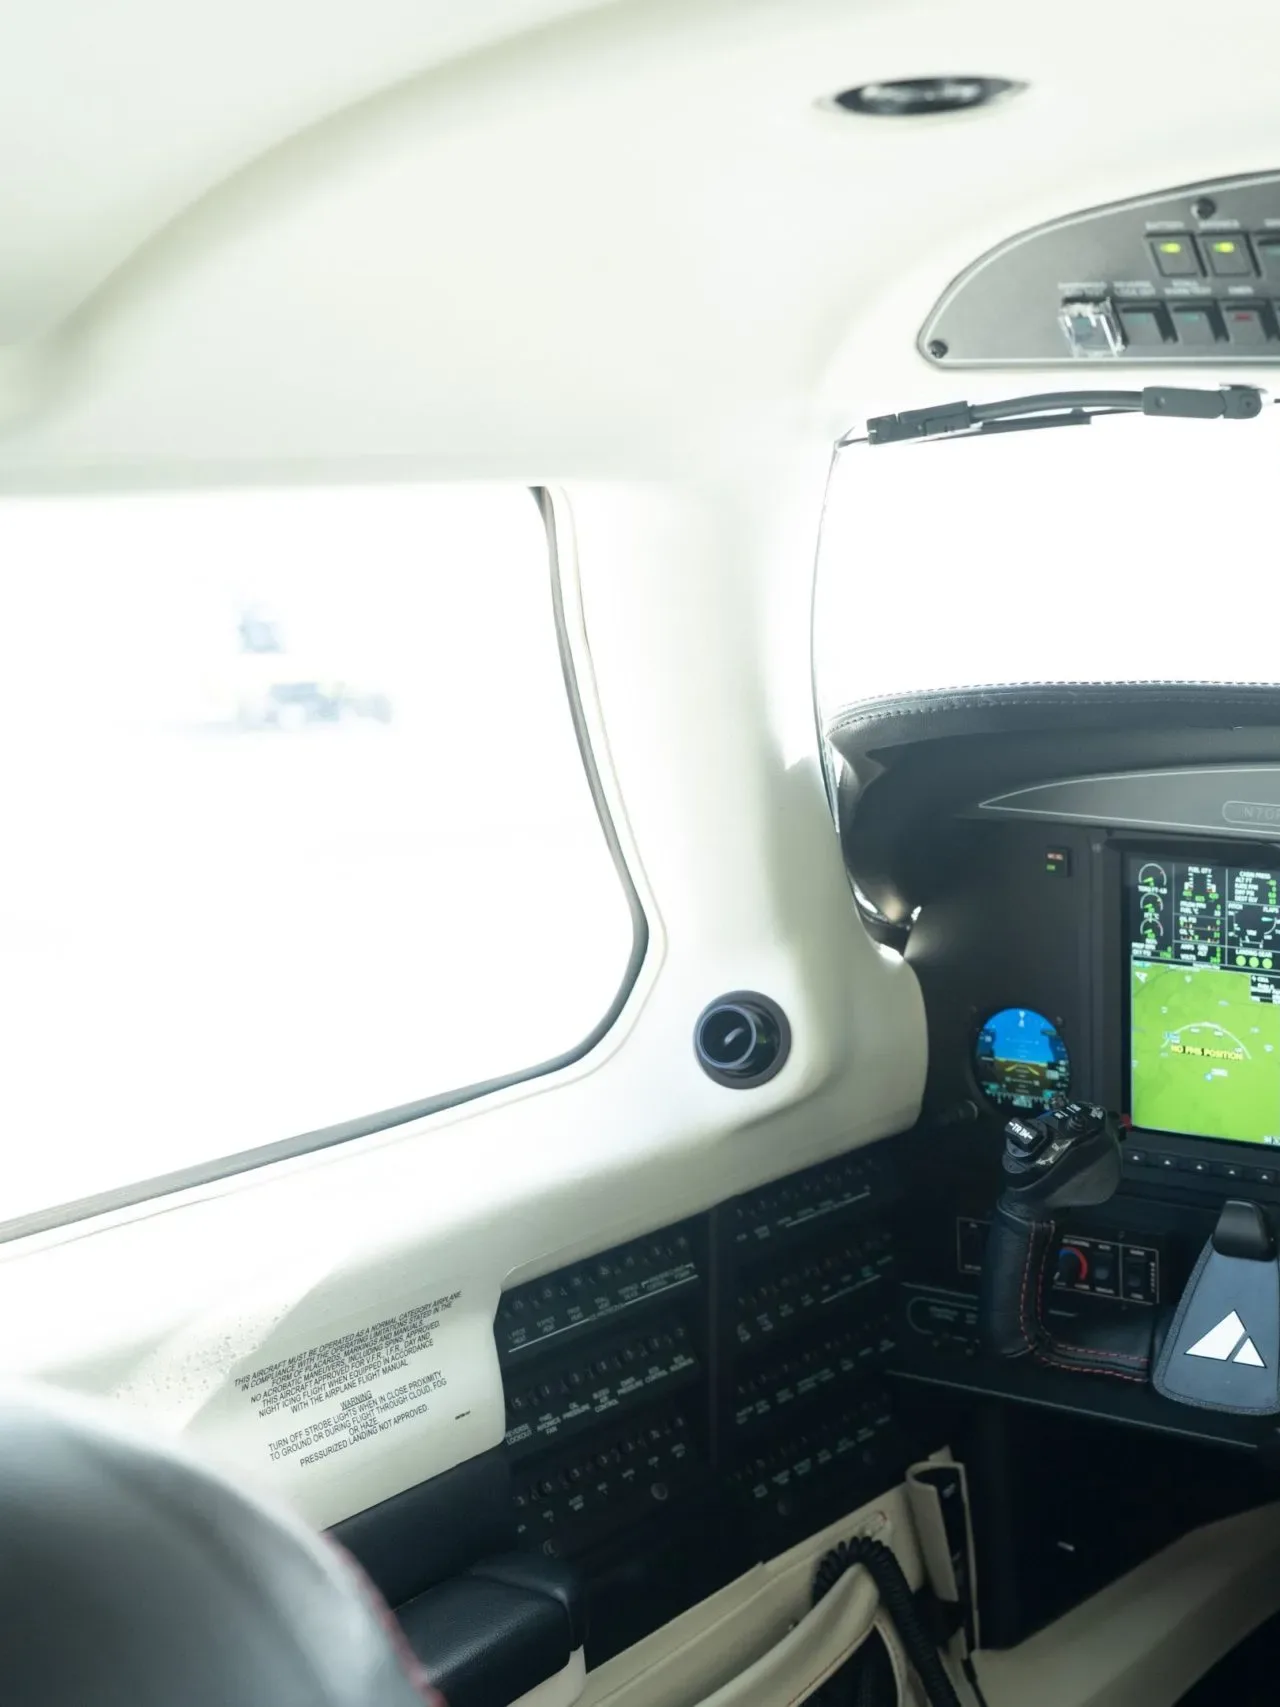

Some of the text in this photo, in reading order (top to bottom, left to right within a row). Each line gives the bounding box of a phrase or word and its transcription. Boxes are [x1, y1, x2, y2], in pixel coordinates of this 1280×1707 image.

[268, 1437, 288, 1452] TURN
[289, 1431, 302, 1443] OFF
[304, 1418, 333, 1436] STROBE
[333, 1407, 357, 1424] LIGHTS
[359, 1399, 378, 1412] WHEN
[387, 1385, 409, 1400] CLOSE
[408, 1370, 442, 1390] PROXIMITY
[291, 1359, 408, 1413] WITH THE AIRPLANE FLIGHT MANUAL
[340, 1390, 372, 1411] WARNING
[270, 1451, 280, 1461] TO
[281, 1437, 312, 1456] GROUND
[312, 1433, 324, 1442] OR
[324, 1420, 351, 1437] DURING
[352, 1409, 375, 1424] FLIGHT
[376, 1396, 408, 1414] THROUGH
[433, 1378, 447, 1389] FOG
[300, 1404, 429, 1467] PRESSURIZED LANDING NOT APPROVED.
[349, 1417, 379, 1436] OR HAZE
